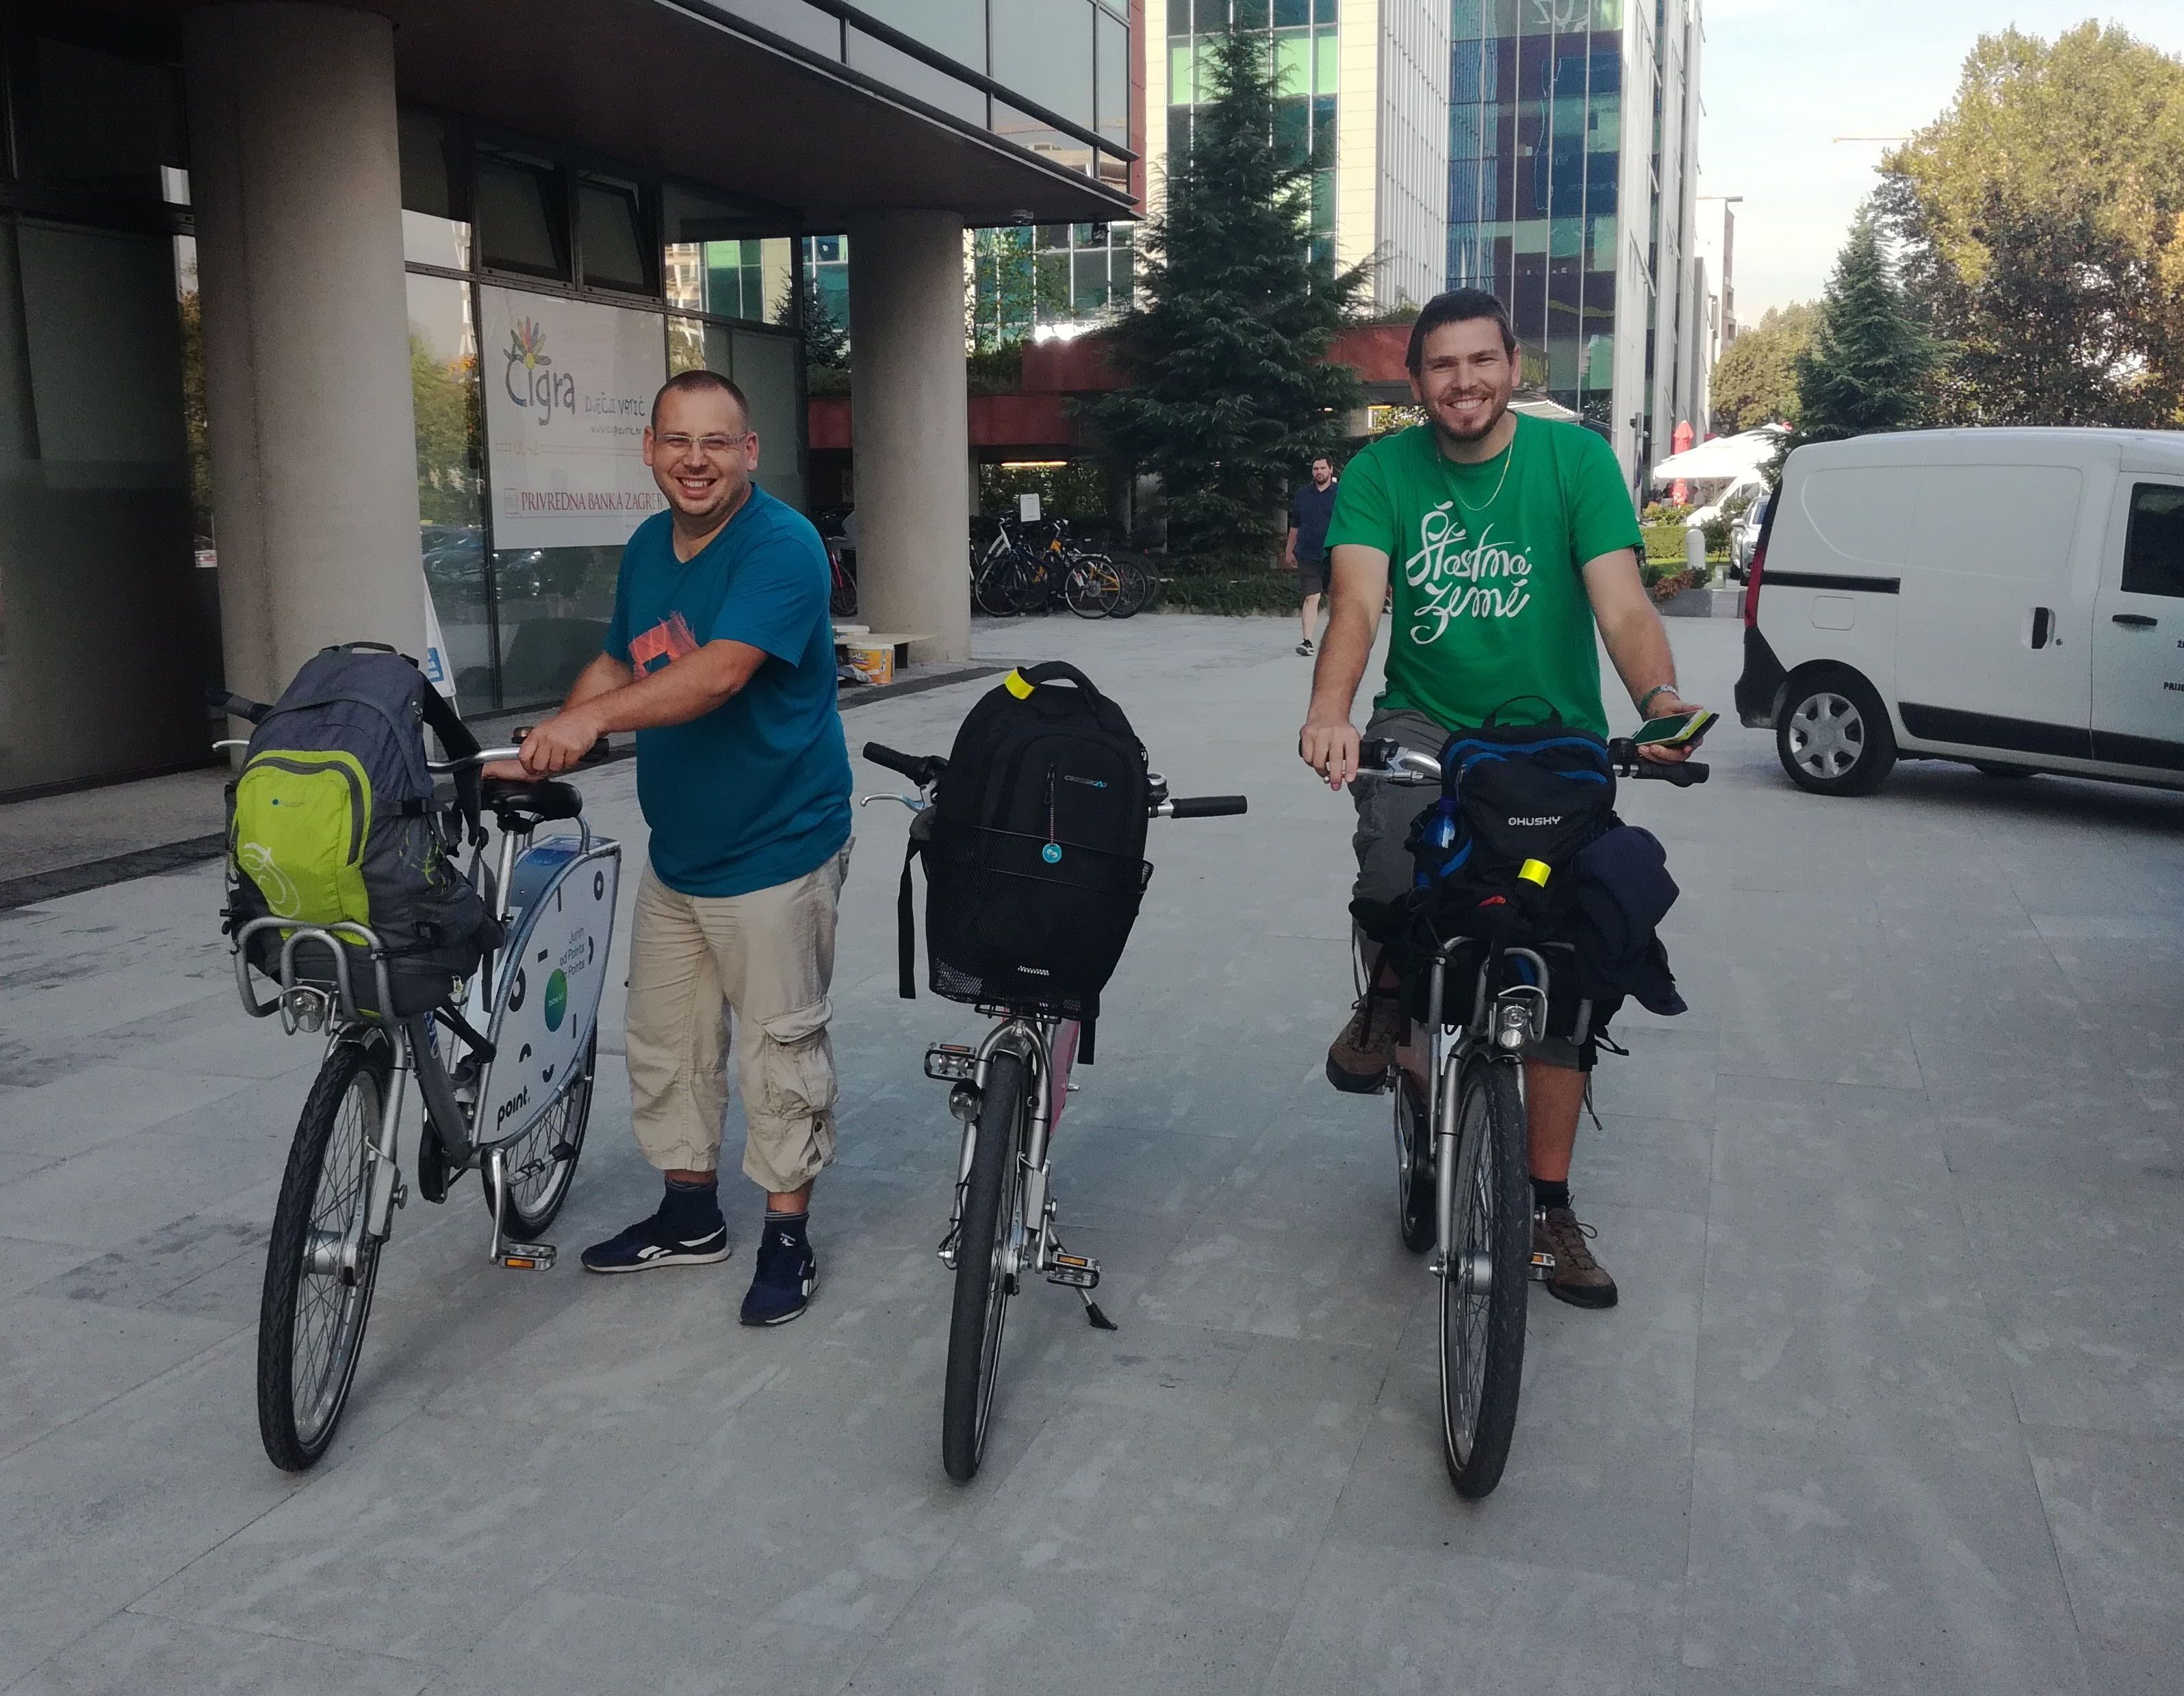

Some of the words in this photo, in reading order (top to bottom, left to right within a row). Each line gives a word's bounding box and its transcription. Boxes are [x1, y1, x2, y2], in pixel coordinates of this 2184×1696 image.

[521, 491, 587, 511] PRIVREDNA
[588, 492, 624, 511] BANKA
[625, 492, 663, 511] ZAGREB
